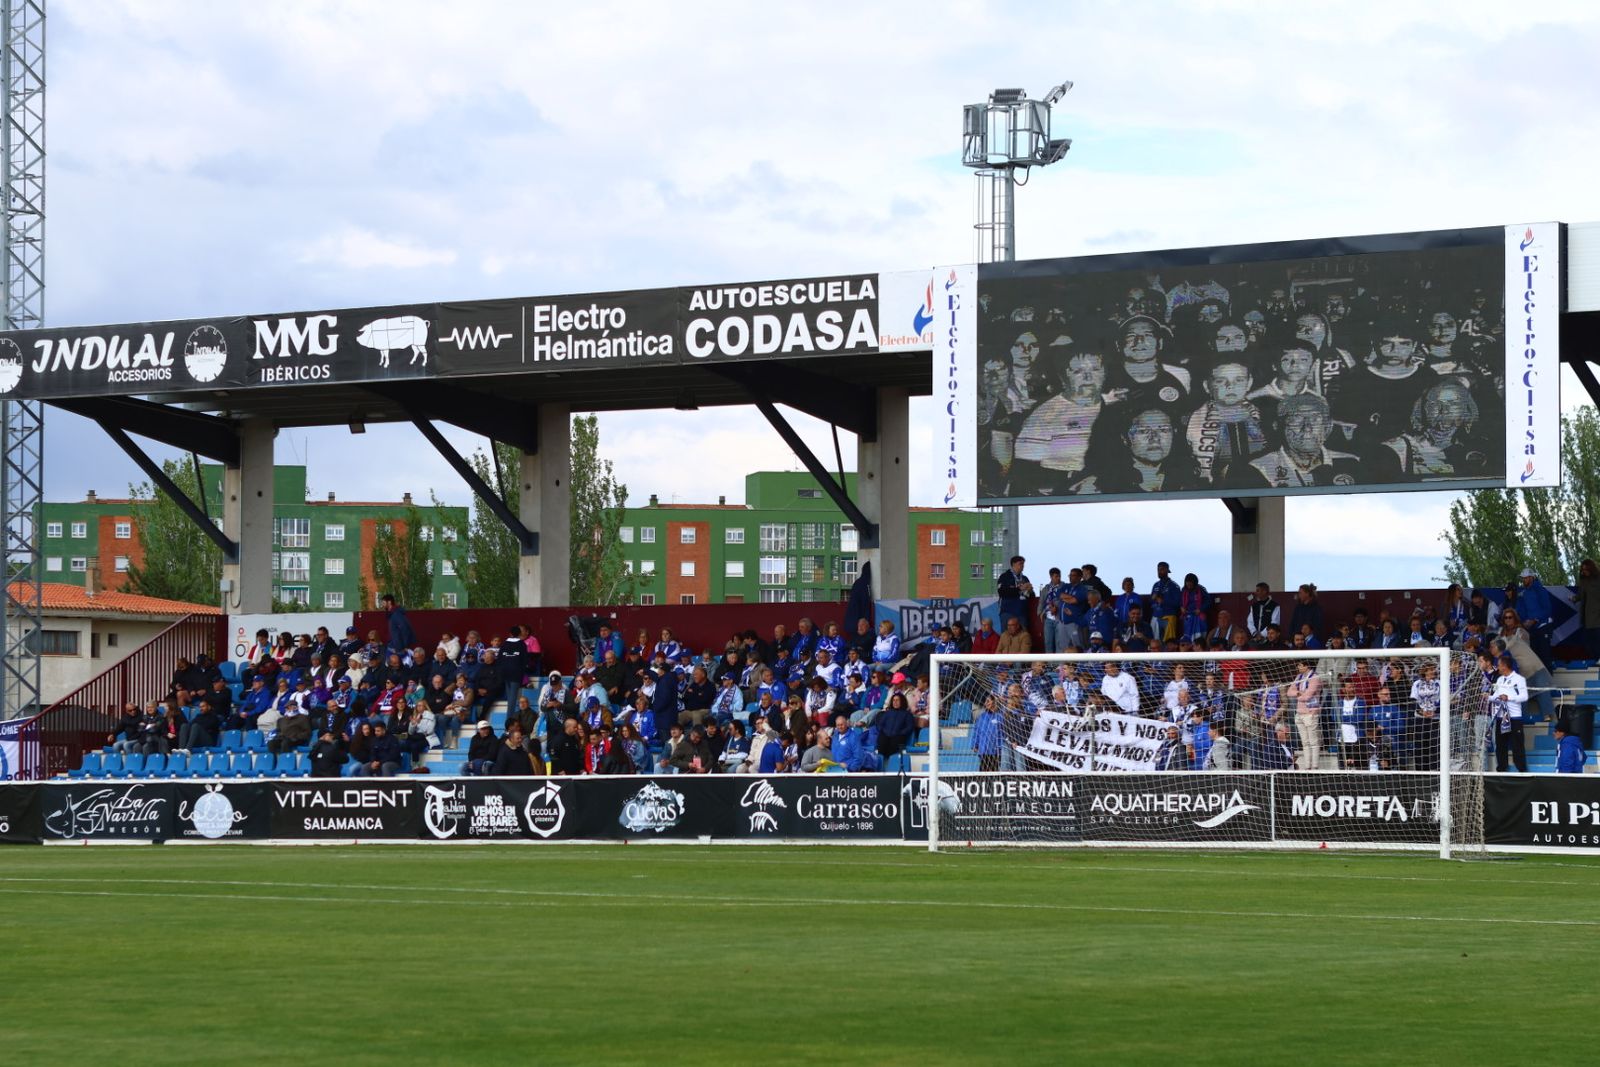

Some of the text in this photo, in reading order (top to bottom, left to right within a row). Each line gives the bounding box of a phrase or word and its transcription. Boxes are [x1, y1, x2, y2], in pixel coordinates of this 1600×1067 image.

[689, 279, 876, 311] AUTOESCUELA
[534, 304, 626, 332] Electro
[252, 315, 339, 359] MMG
[685, 308, 879, 358] CODASA
[32, 332, 175, 373] INDUAL
[534, 330, 673, 361] Helmántica
[108, 367, 172, 382] ACCESORIOS
[261, 364, 331, 382] IBÉRICOS
[1117, 720, 1128, 736] Y
[1135, 723, 1168, 741] NOS
[111, 784, 145, 808] La
[815, 786, 877, 801] La Hoja del
[953, 781, 1074, 798] HOLDERMAN
[275, 790, 413, 807] VITALDENT
[484, 795, 503, 806] NOS
[796, 794, 898, 819] Carrasco
[1090, 789, 1250, 815] AQUATHERAPIA
[472, 805, 504, 817] VEMOS
[505, 805, 516, 816] EN
[530, 808, 559, 816] ECCOLA
[953, 802, 1076, 813] MULTIMEDIA
[1291, 795, 1408, 822] MORETA
[1530, 801, 1560, 824] El
[304, 817, 384, 830] SALAMANCA
[471, 816, 489, 827] LOS
[490, 816, 519, 827] BARES
[820, 822, 850, 831] Guijuelo
[857, 822, 874, 831] 1896
[1091, 816, 1179, 824] SPA CENTER
[1532, 834, 1599, 844] AUTOES
